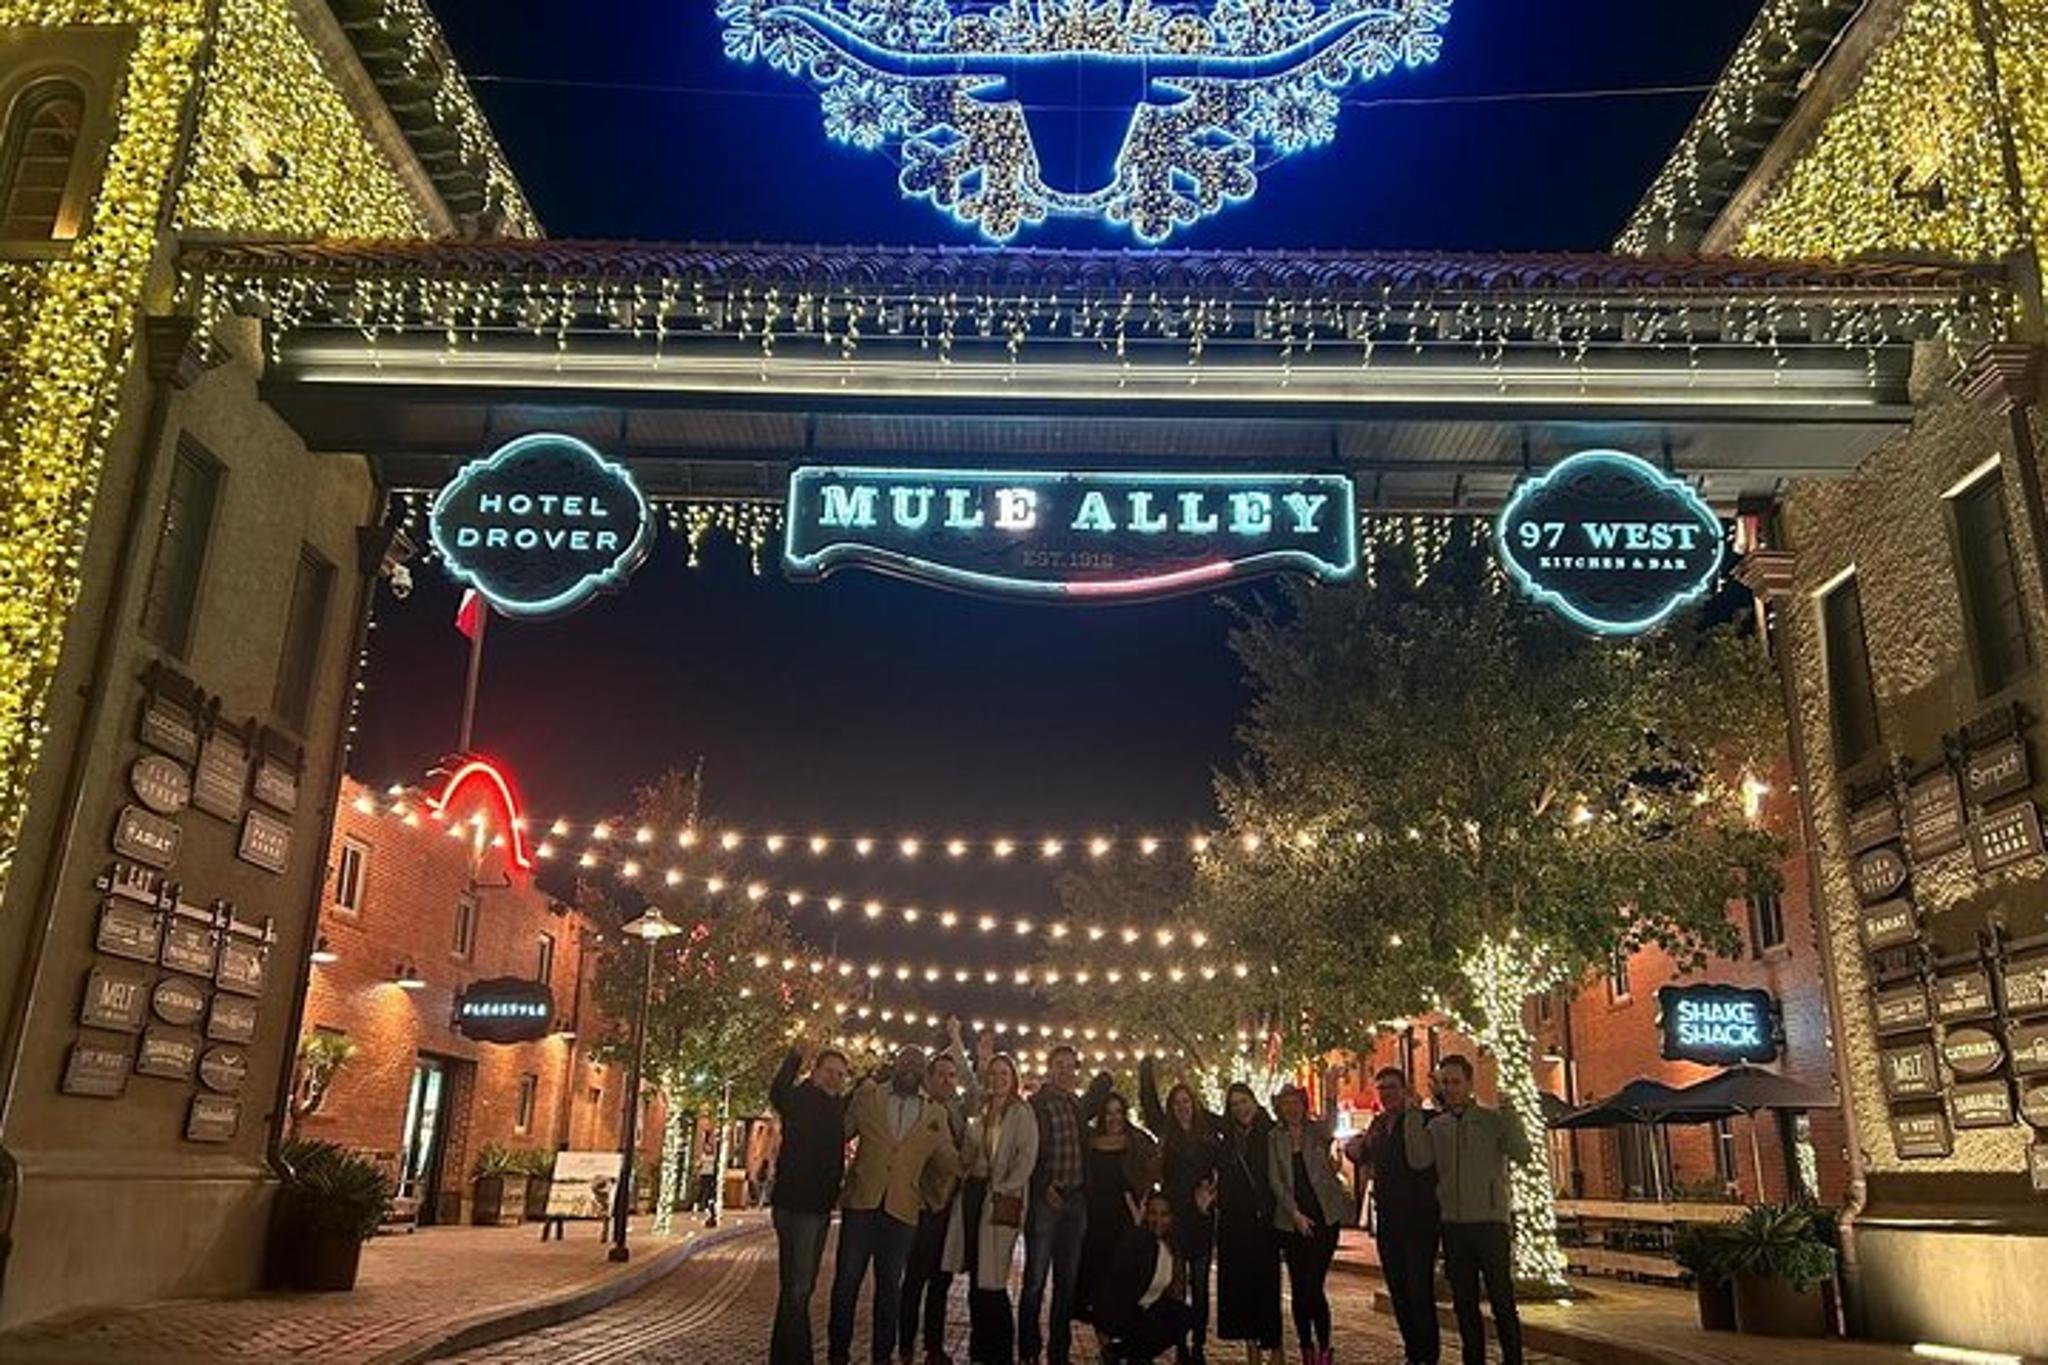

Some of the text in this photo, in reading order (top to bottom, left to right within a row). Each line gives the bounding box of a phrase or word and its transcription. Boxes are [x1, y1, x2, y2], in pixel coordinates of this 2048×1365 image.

[479, 493, 608, 517] HOTEL
[819, 485, 1329, 535] MULE ALLEY
[456, 528, 619, 550] DROVER
[1518, 521, 1700, 550] 97 WEST
[1539, 556, 1687, 570] KITCHEN & BAR
[1677, 1000, 1756, 1023] SHAKE
[1677, 1022, 1761, 1046] SHACK
